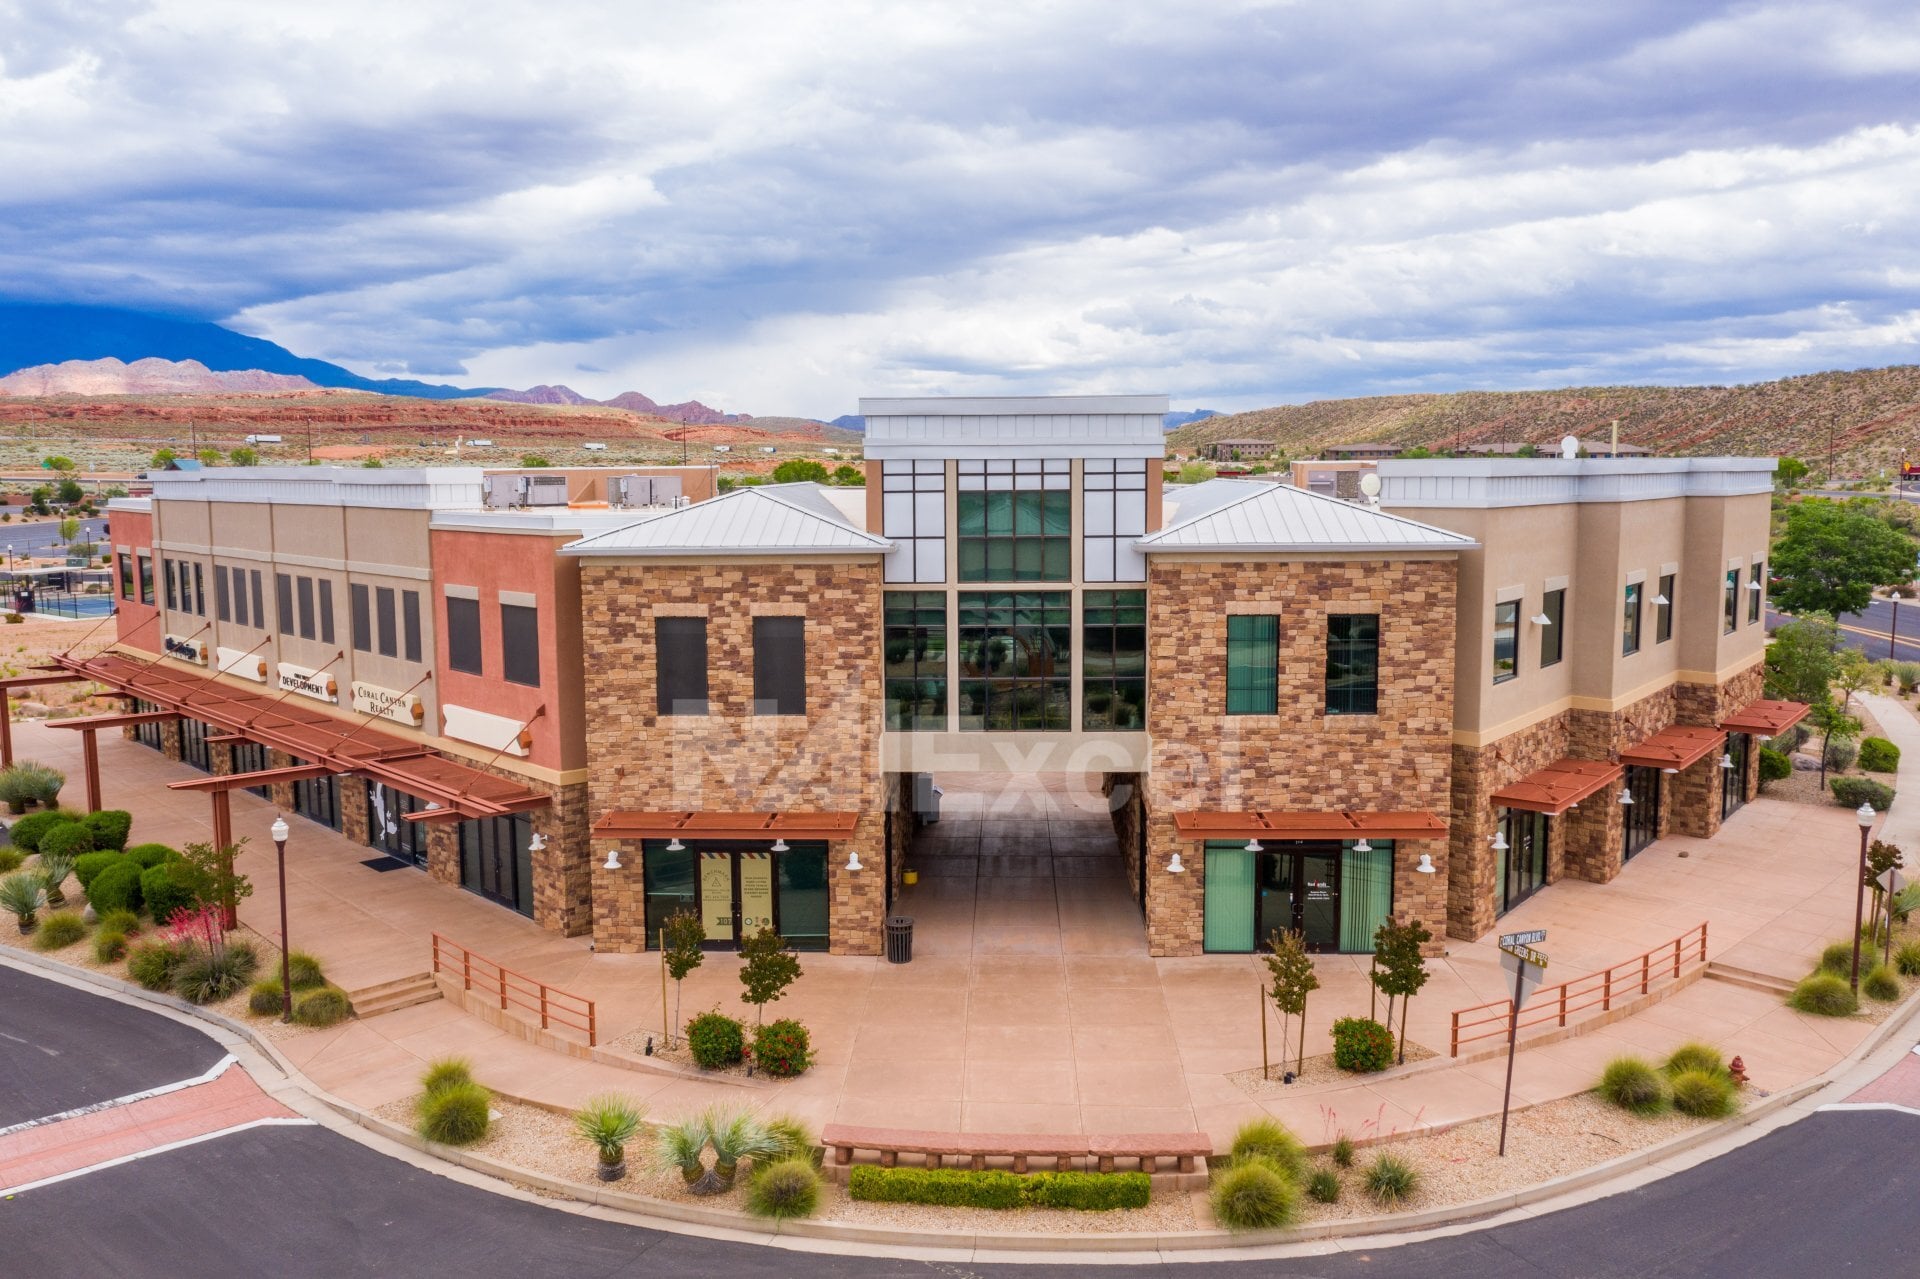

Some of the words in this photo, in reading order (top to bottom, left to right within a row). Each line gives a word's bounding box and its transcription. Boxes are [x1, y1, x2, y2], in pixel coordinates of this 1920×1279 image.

[282, 676, 323, 695] DEVELOPMENT
[358, 687, 378, 700] CORAL
[380, 692, 406, 708] CANYON
[370, 701, 394, 717] REALTY
